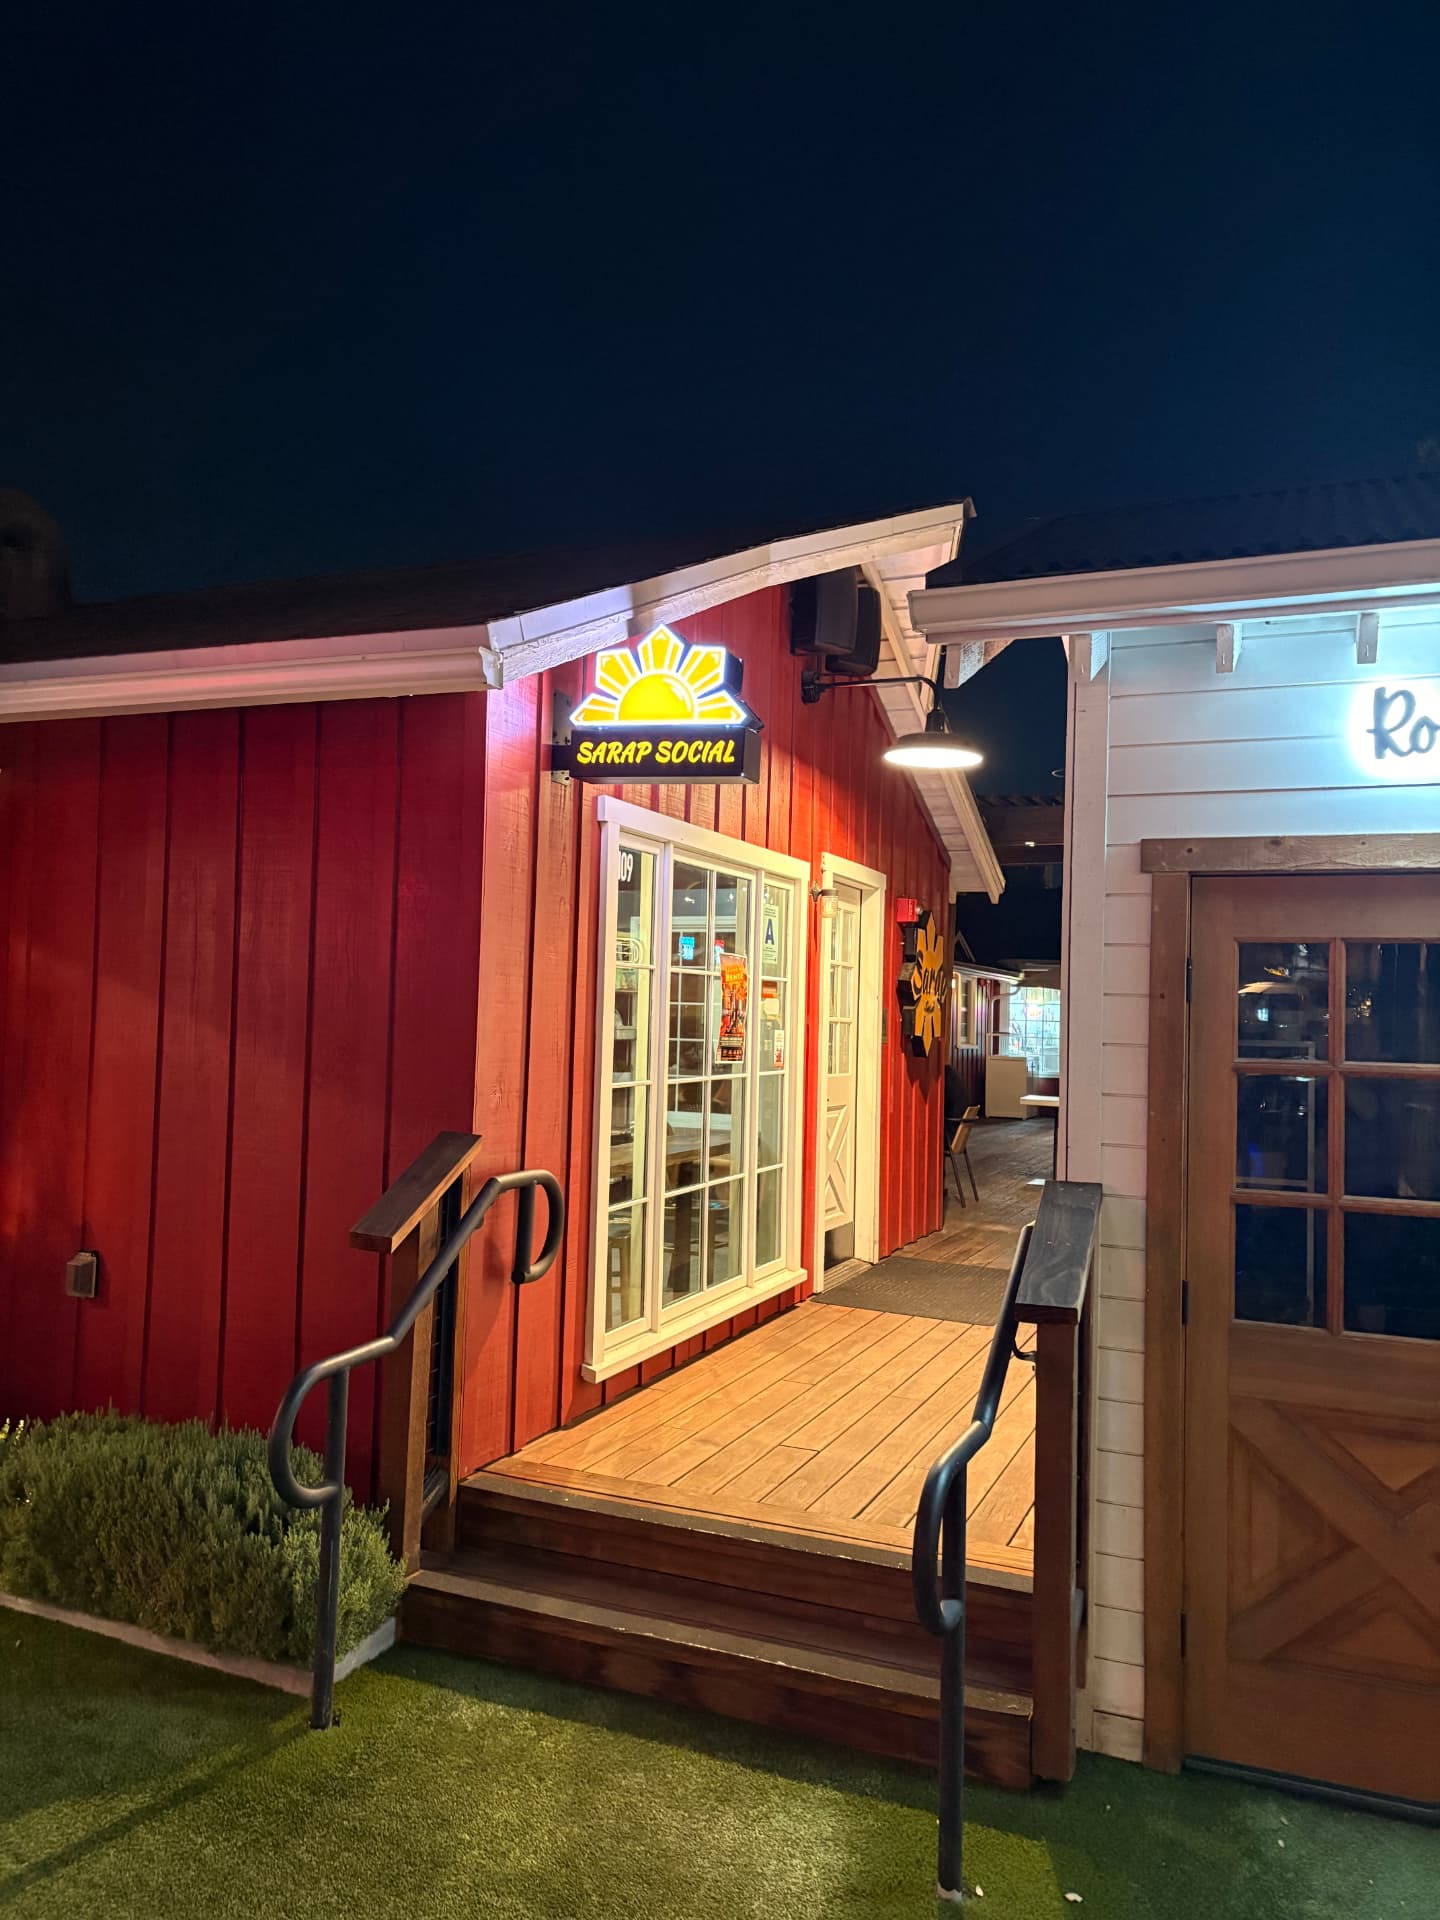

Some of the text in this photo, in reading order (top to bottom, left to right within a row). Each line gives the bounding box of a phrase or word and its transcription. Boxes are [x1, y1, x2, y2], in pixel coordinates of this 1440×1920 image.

[576, 740, 735, 764] SARAP SOCIAL
[764, 918, 775, 945] A
